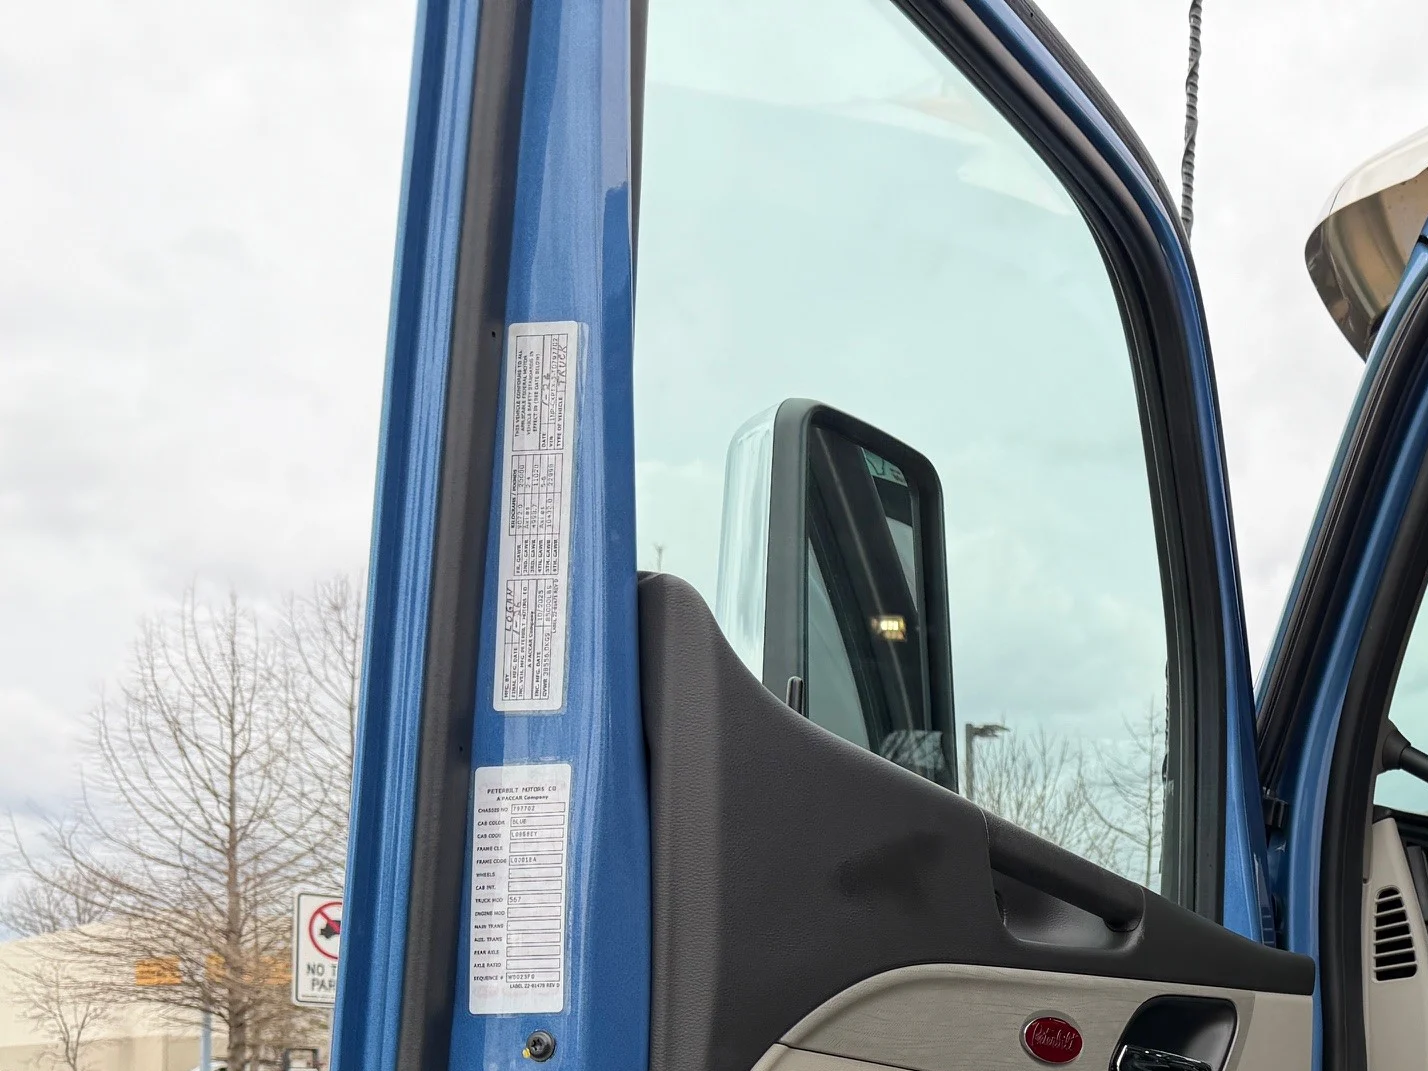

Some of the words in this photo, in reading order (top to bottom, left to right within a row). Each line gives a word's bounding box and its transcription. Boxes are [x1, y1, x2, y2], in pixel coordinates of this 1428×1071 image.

[557, 344, 567, 386] TRUCK
[505, 588, 513, 631] LOGAN
[306, 962, 325, 976] NO
